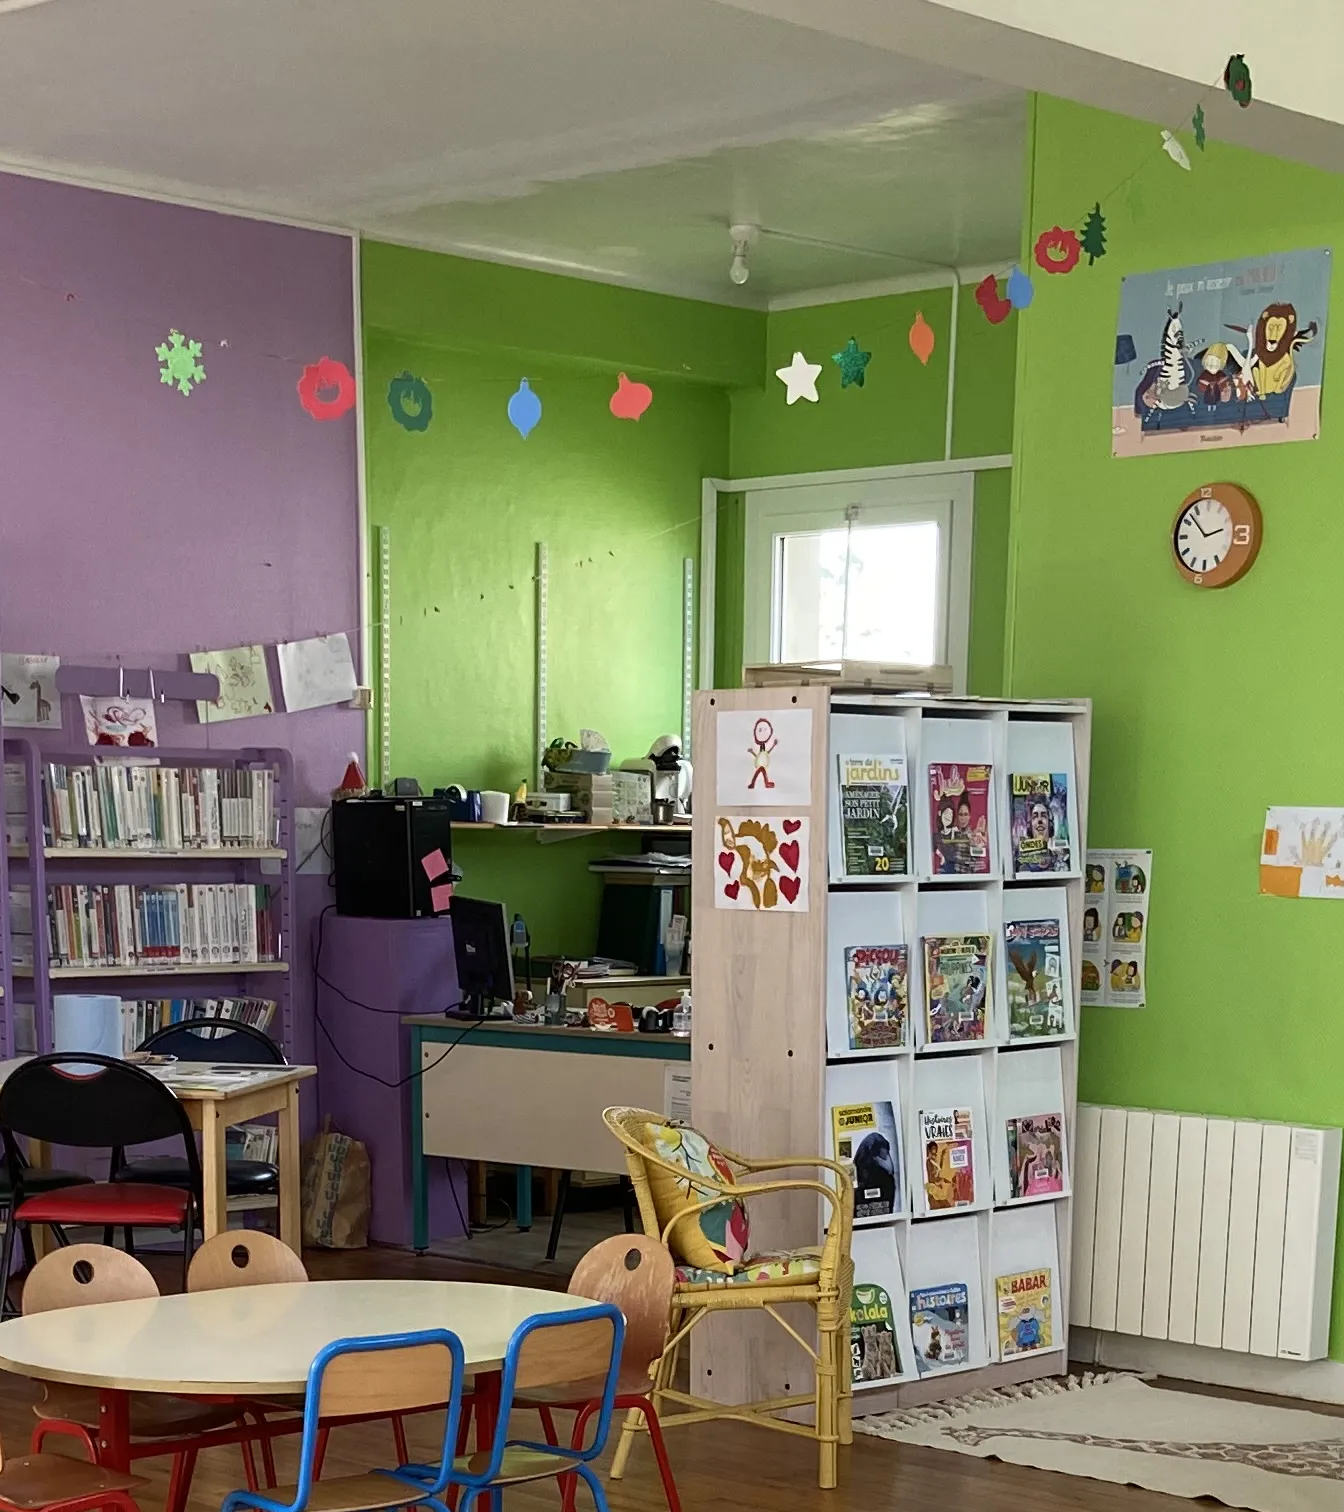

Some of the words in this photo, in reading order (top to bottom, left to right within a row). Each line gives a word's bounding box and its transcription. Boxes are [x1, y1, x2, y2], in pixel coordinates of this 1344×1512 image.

[1200, 488, 1212, 498] 12
[1233, 524, 1250, 545] 3
[1193, 574, 1203, 584] 6
[846, 759, 900, 787] jardins
[845, 807, 881, 819] JARDIN
[874, 857, 890, 872] 20
[924, 1124, 953, 1139] VRAIES
[1011, 1274, 1048, 1294] BABAR
[917, 1292, 967, 1310] histoires
